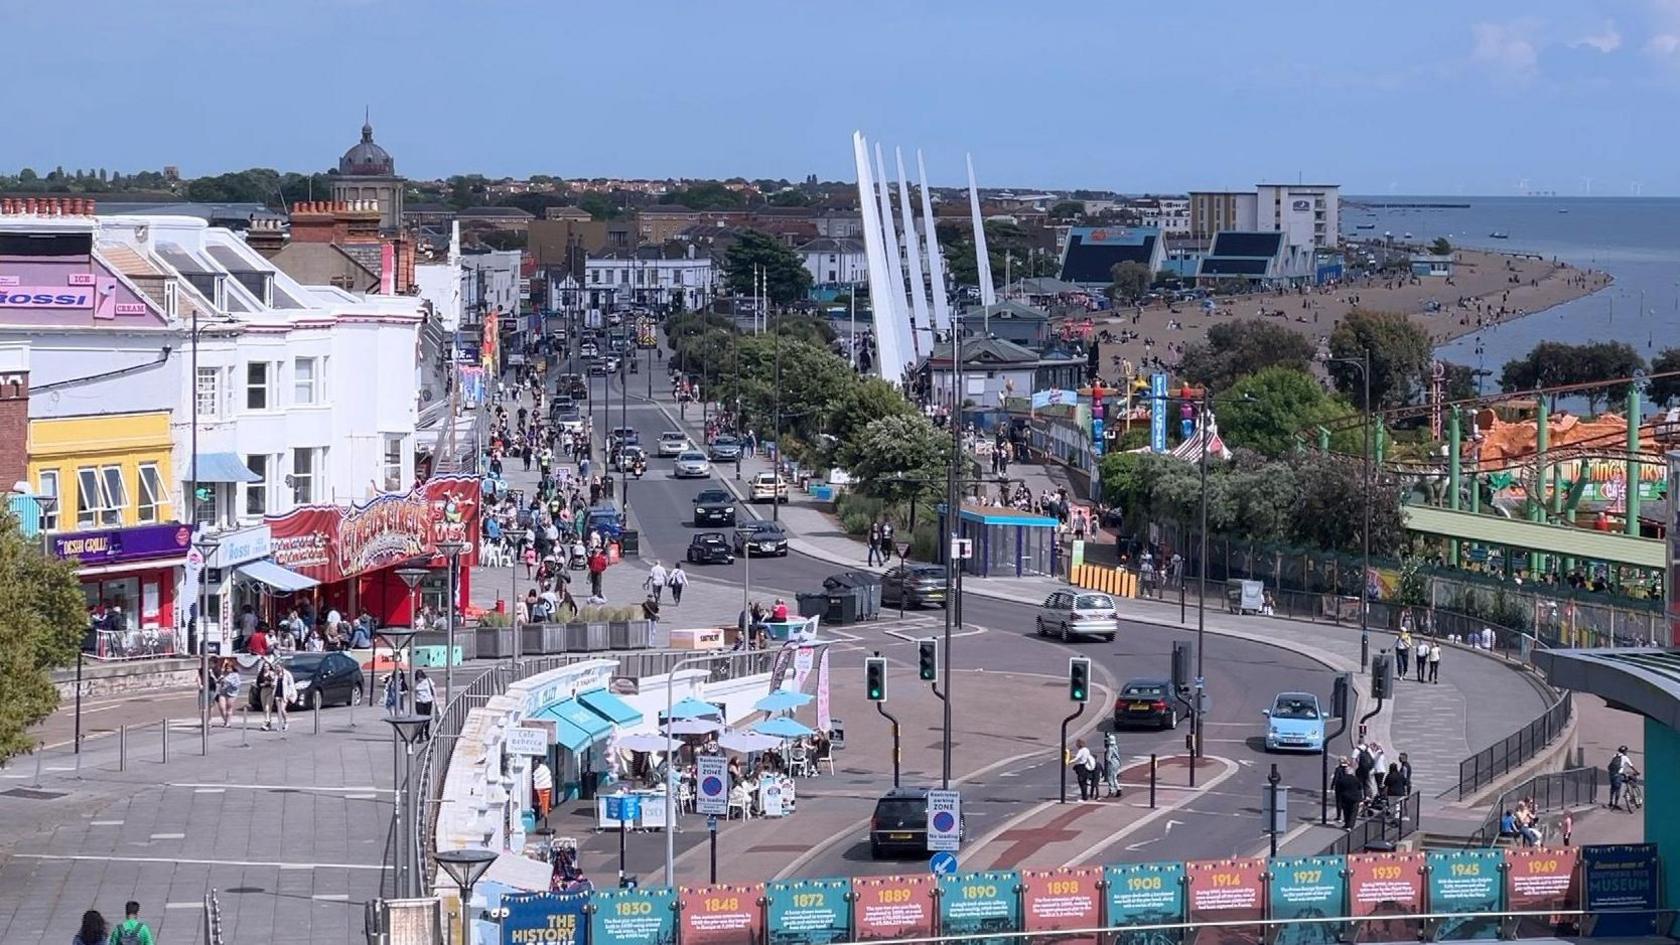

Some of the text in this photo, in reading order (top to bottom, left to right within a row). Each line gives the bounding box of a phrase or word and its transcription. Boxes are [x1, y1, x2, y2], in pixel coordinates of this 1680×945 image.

[74, 275, 91, 283] ICE
[117, 304, 144, 313] CREAM
[1372, 866, 1401, 879] 1939
[1451, 863, 1480, 876] 1945
[1528, 860, 1557, 873] 1949
[1128, 876, 1161, 890] 1908
[1212, 873, 1241, 887] 1914
[1293, 870, 1322, 883] 1927
[962, 885, 997, 899] 1890
[1047, 880, 1079, 894] 1898
[1589, 878, 1649, 892] MUSEUM
[793, 893, 824, 907] 1872
[878, 888, 911, 903] 1889
[615, 902, 652, 915] 1830
[704, 897, 738, 911] 1848
[547, 914, 576, 928] THE
[511, 928, 576, 943] HISTORY
